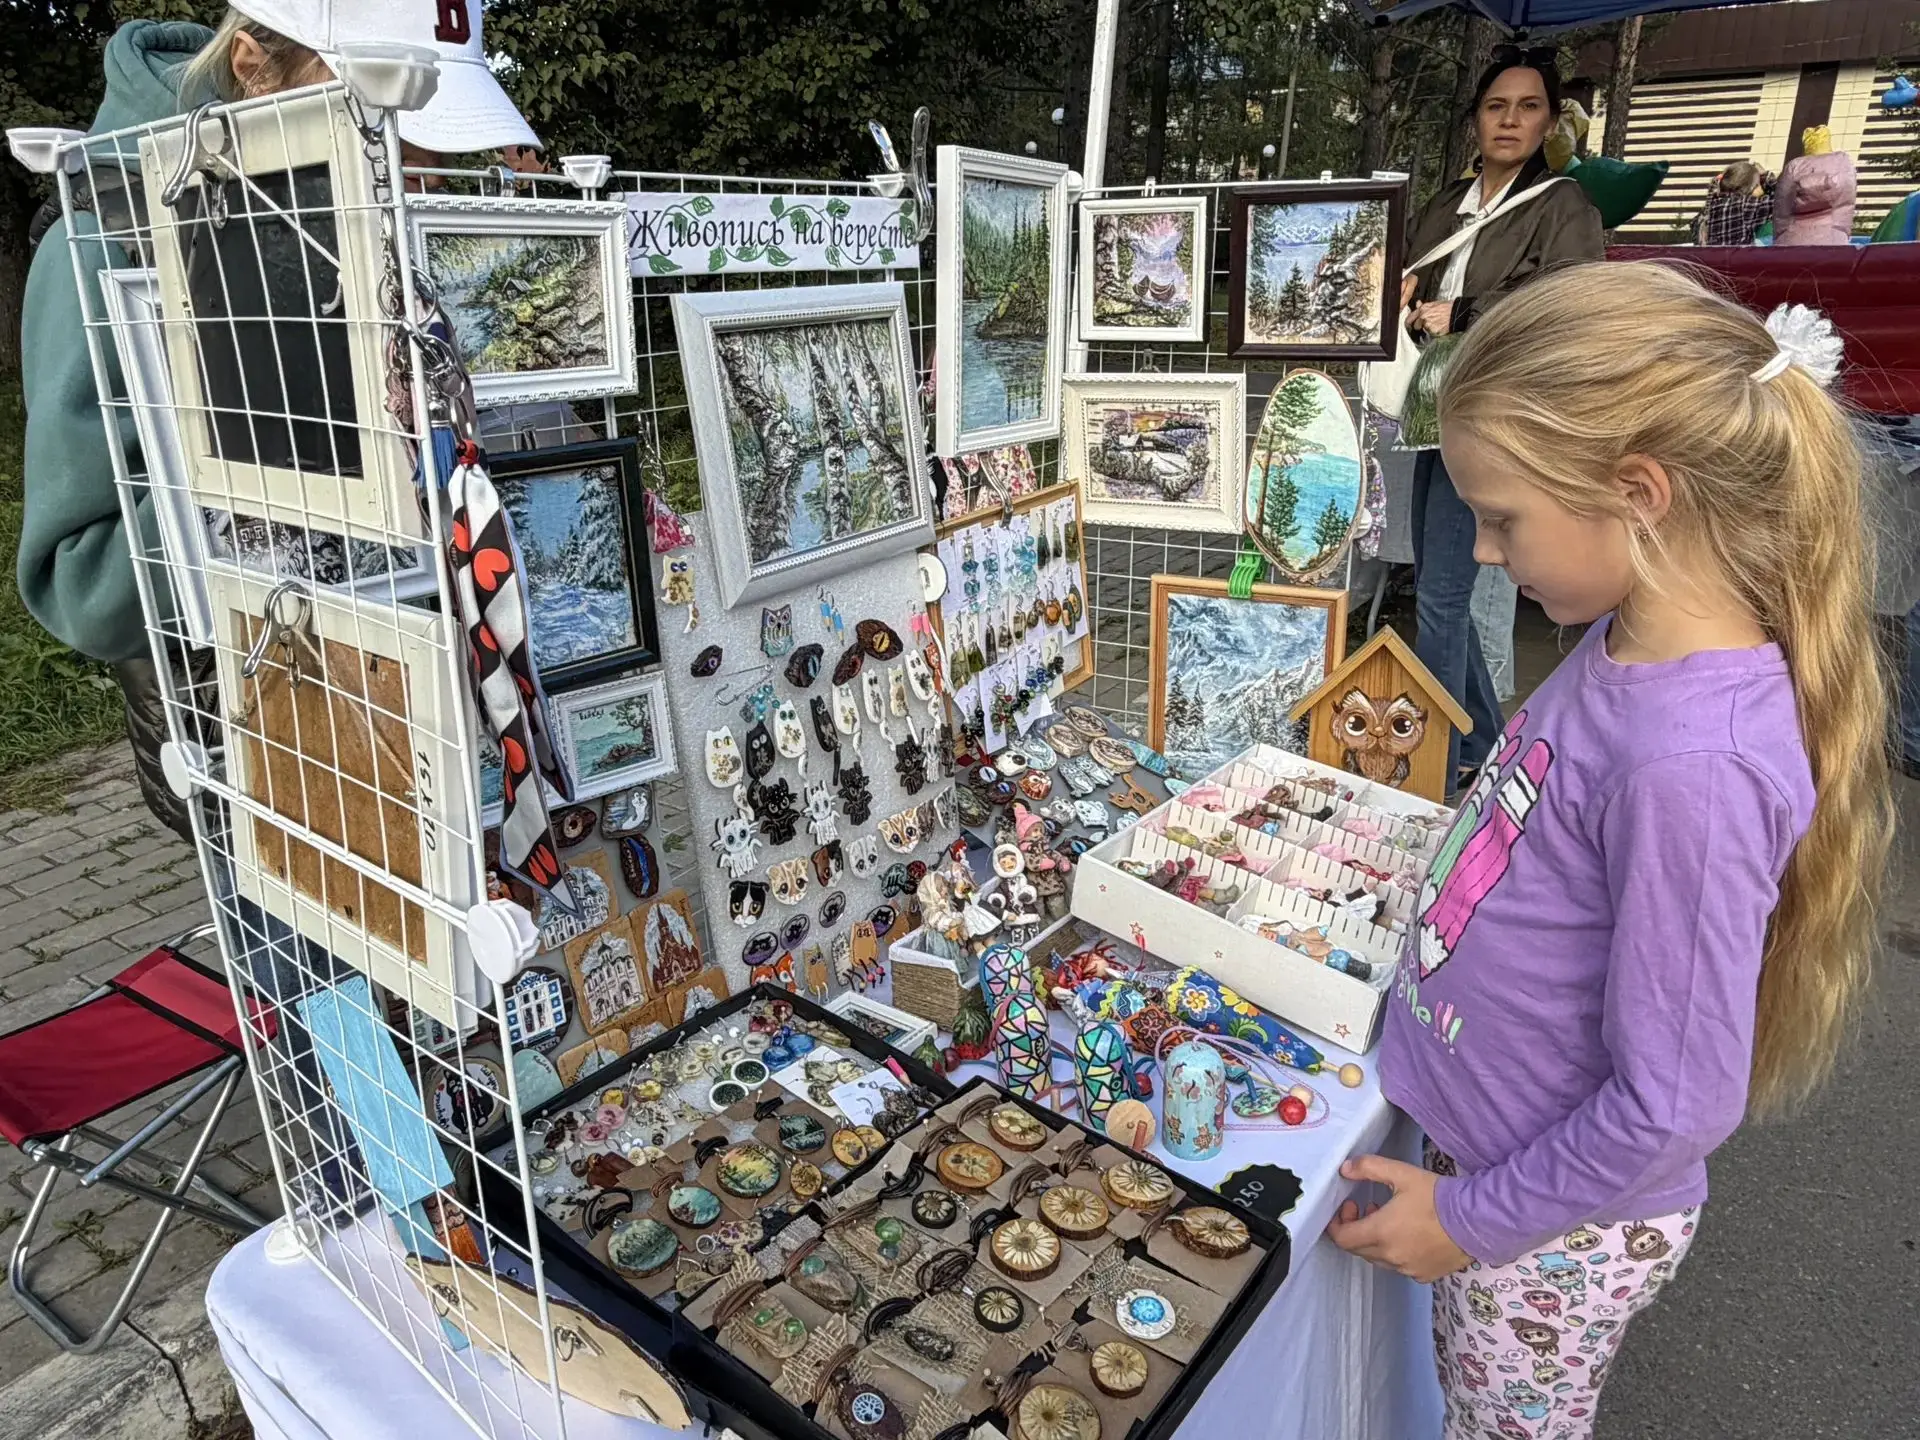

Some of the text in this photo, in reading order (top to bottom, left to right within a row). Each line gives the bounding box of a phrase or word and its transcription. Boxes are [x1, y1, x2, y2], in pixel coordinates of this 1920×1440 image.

[628, 206, 918, 260] Живопись на бересте
[1233, 1180, 1265, 1208] 250
